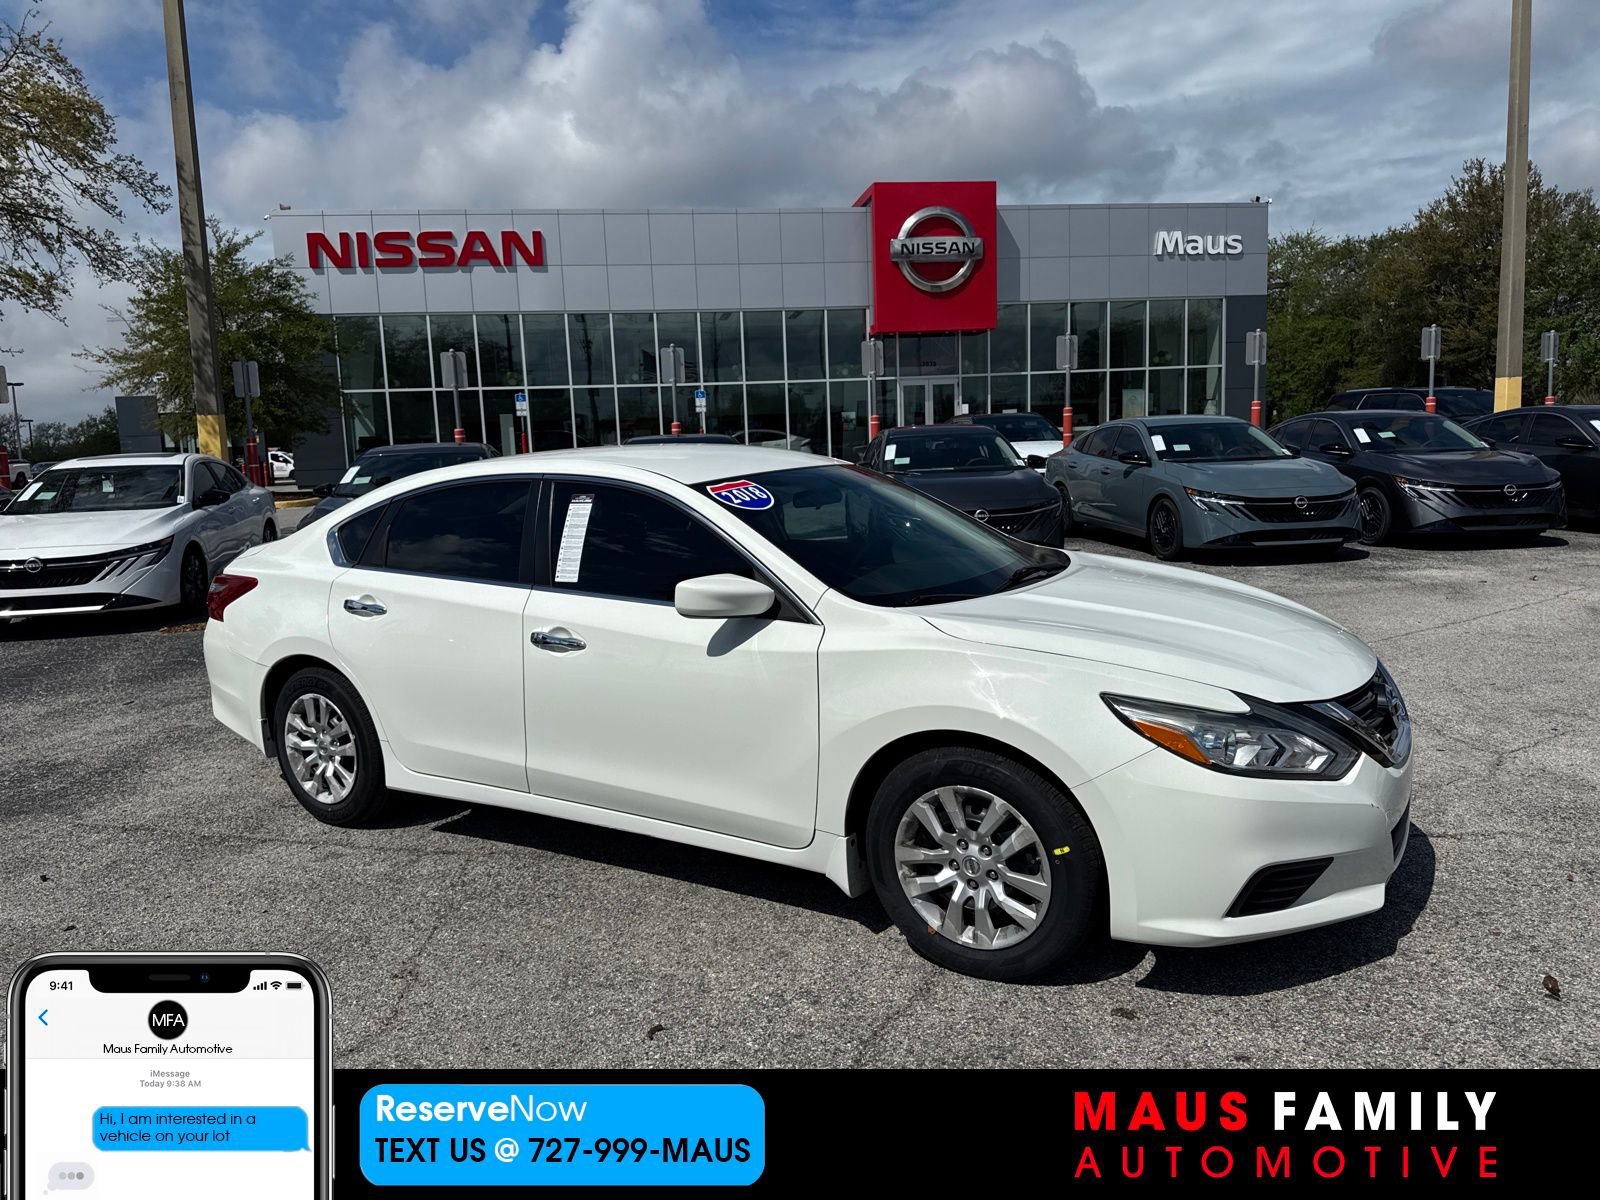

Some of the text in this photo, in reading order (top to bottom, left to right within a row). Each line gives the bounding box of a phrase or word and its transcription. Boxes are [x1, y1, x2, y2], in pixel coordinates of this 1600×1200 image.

[306, 231, 545, 268] NISSAN
[901, 241, 975, 255] NISSAN
[1154, 230, 1243, 256] Maus
[721, 486, 768, 504] 2018
